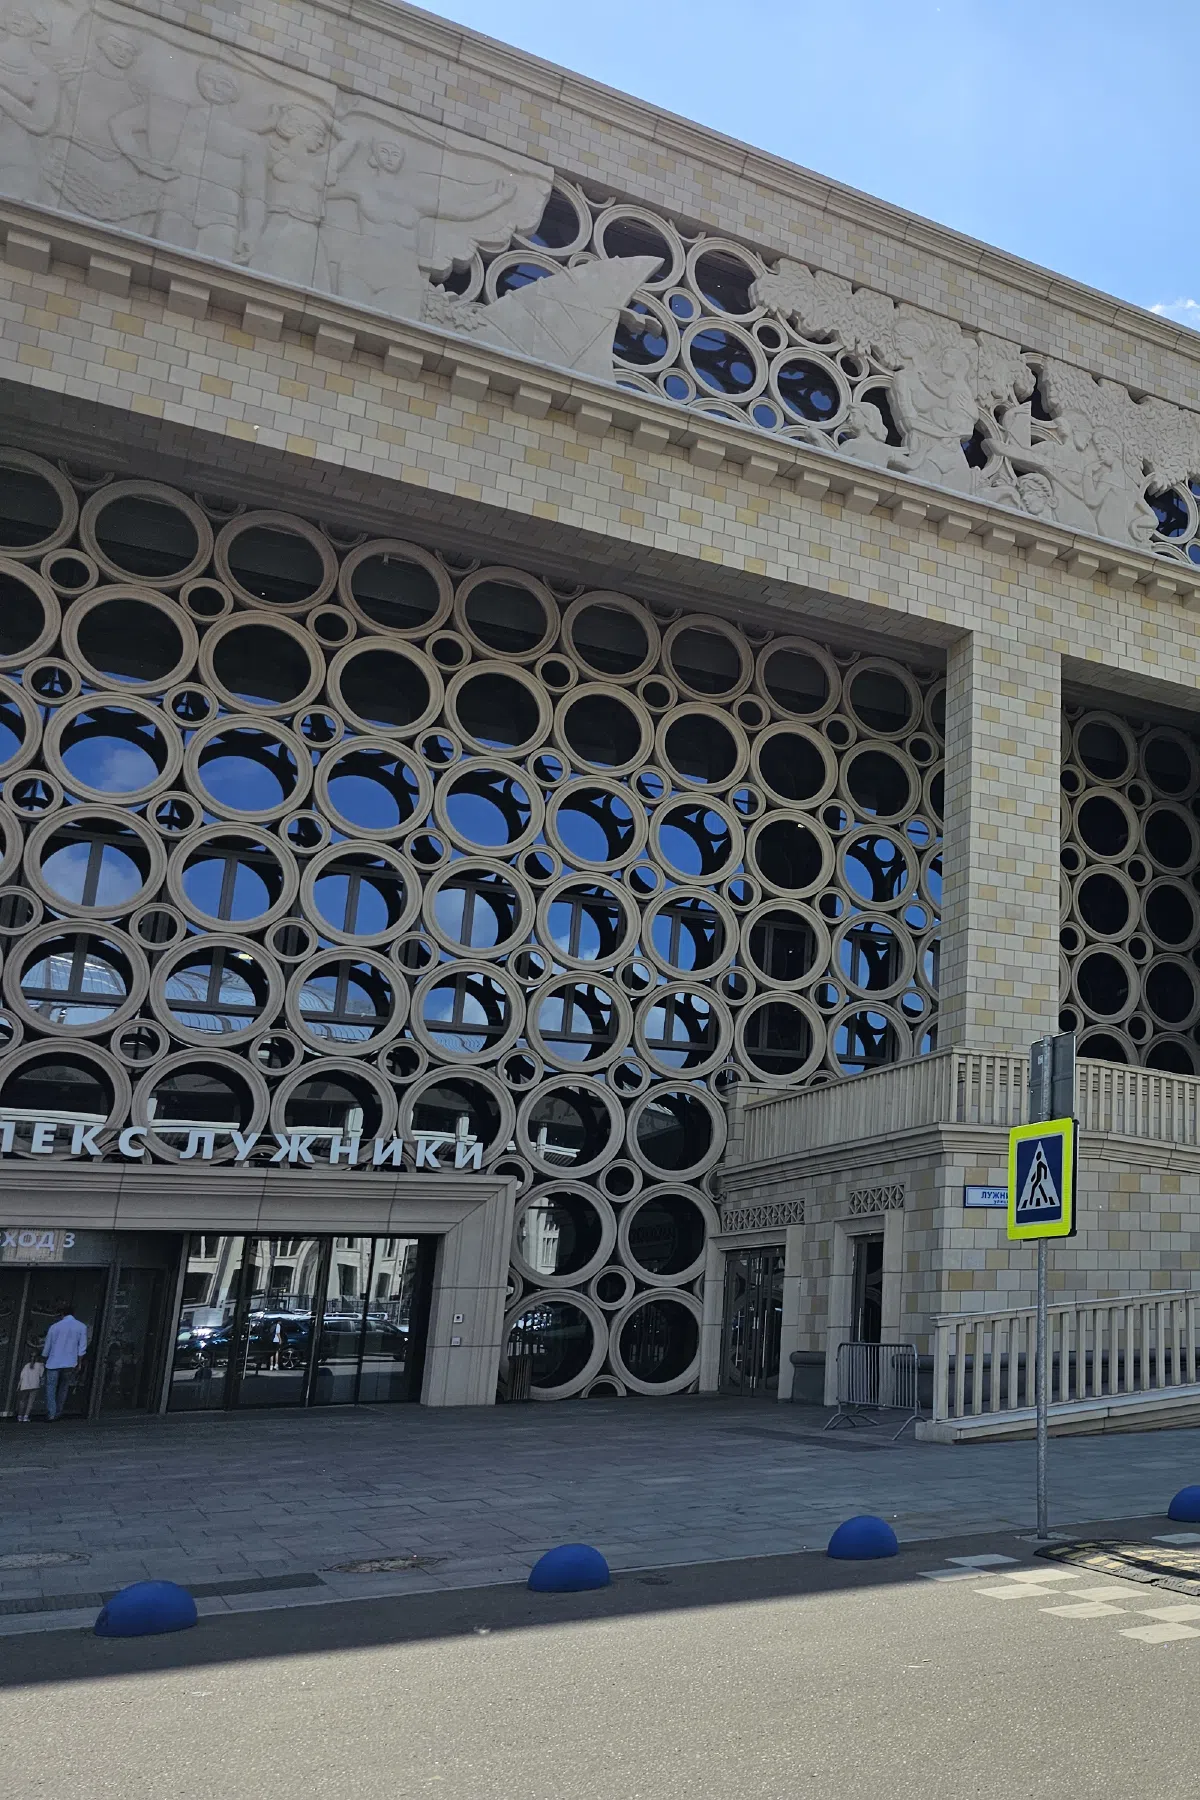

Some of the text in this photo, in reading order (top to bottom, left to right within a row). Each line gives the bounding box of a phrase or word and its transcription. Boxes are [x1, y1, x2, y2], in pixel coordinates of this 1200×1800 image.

[179, 1130, 483, 1170] ЛУЖНИКИ
[0, 1231, 76, 1252] ХОД 3
